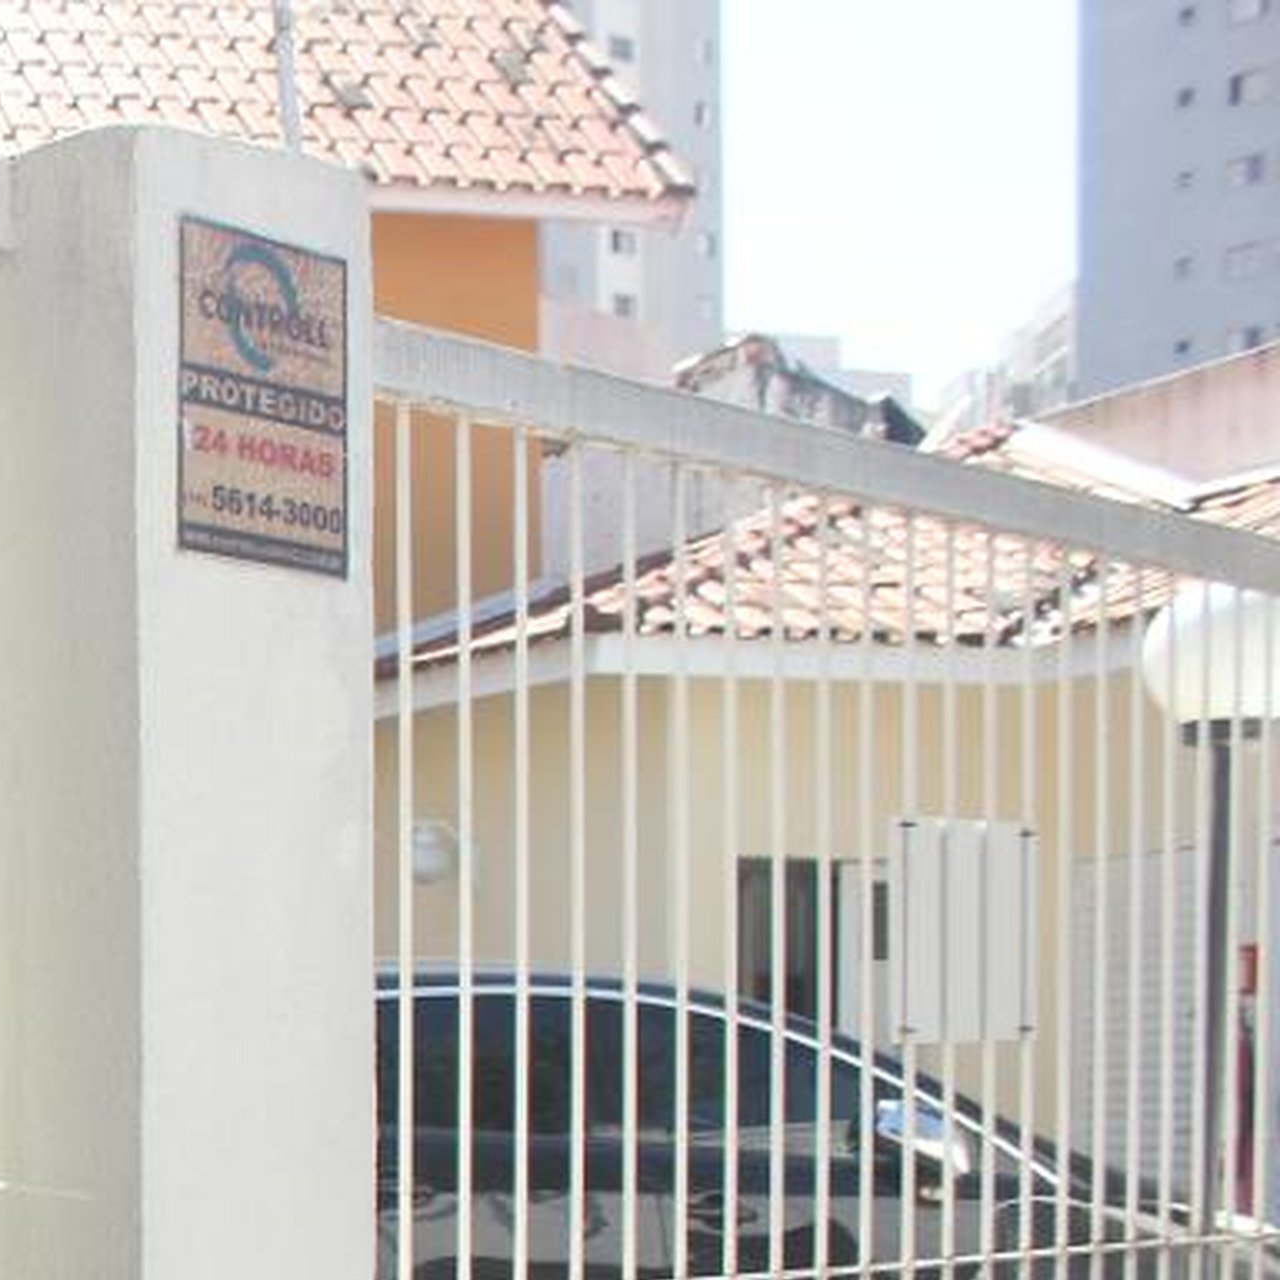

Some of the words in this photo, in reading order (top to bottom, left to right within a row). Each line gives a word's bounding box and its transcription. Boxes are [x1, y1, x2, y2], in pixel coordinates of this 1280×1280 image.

[181, 370, 344, 430] PROTEGIDO
[192, 425, 227, 454] 24
[237, 434, 335, 478] HORAS
